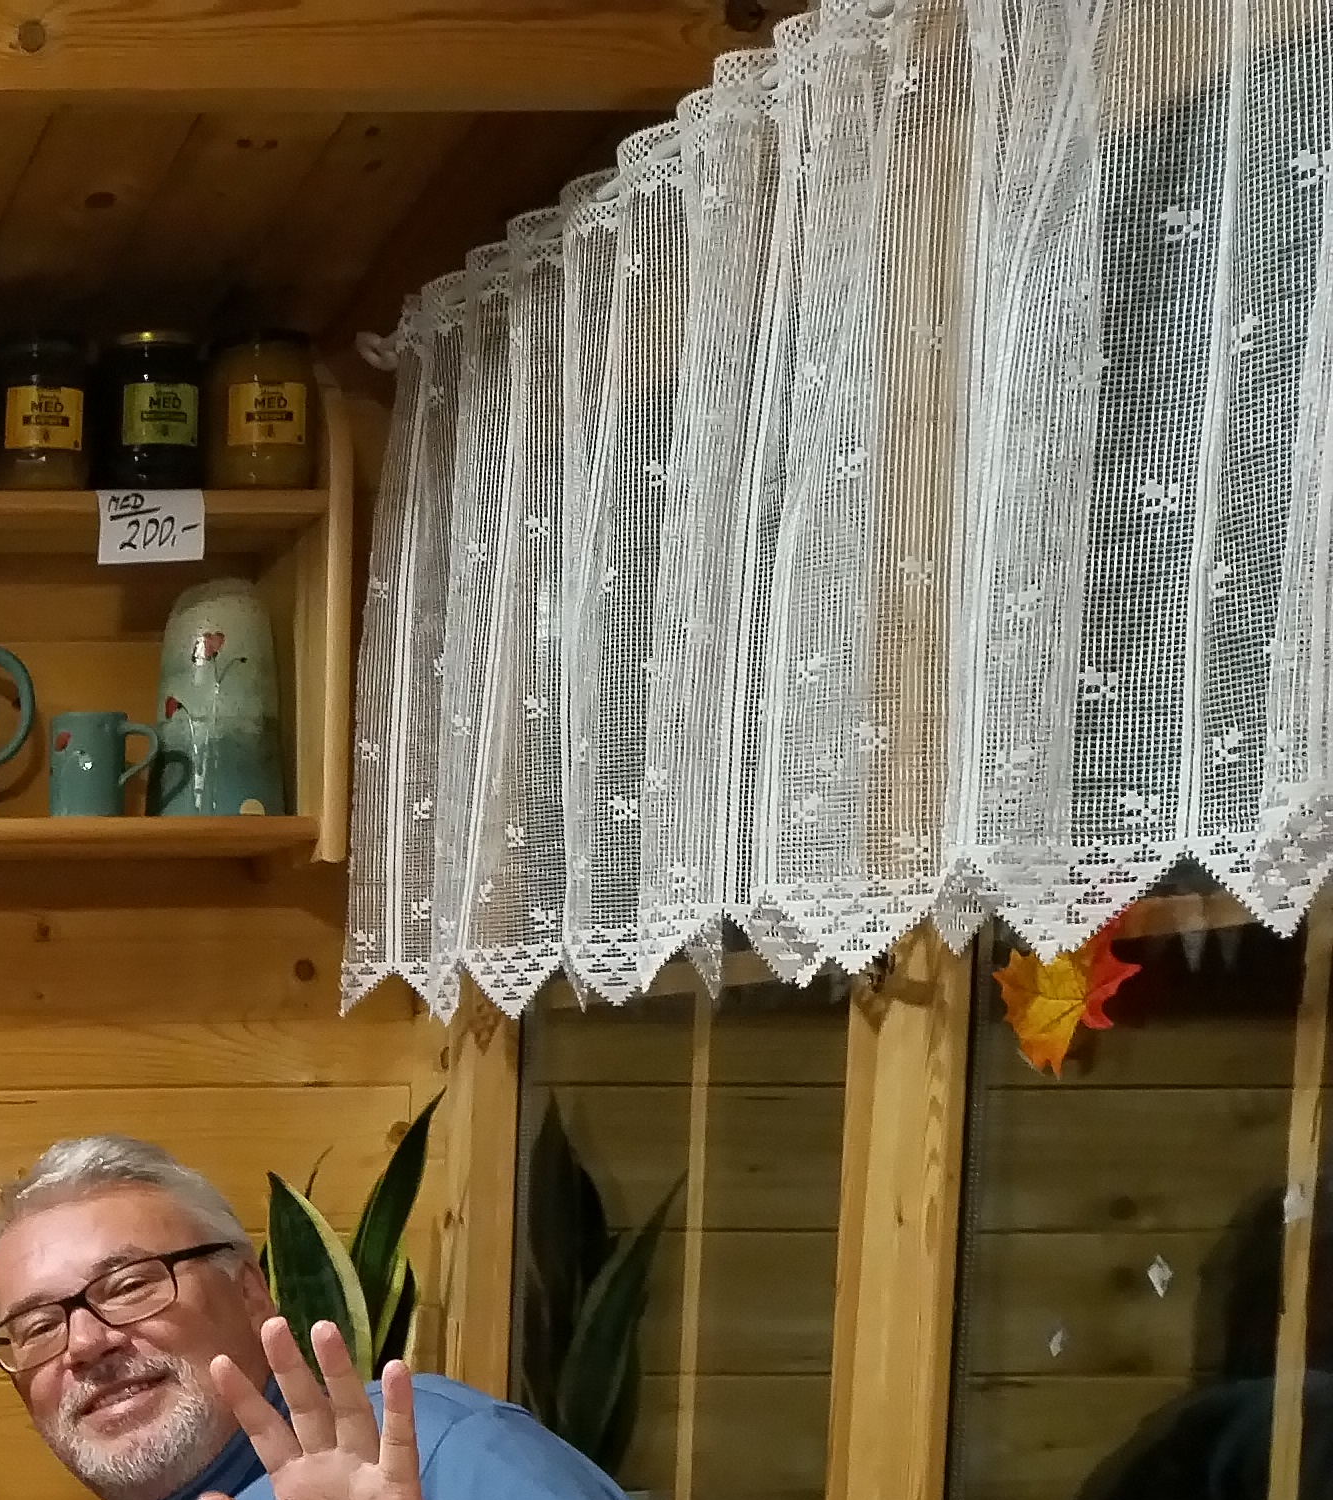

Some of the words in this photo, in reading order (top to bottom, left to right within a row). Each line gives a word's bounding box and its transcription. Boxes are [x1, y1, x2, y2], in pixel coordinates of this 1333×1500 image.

[31, 400, 64, 413] MED
[148, 395, 182, 409] MED
[253, 395, 288, 409] MED
[108, 493, 145, 512] MED
